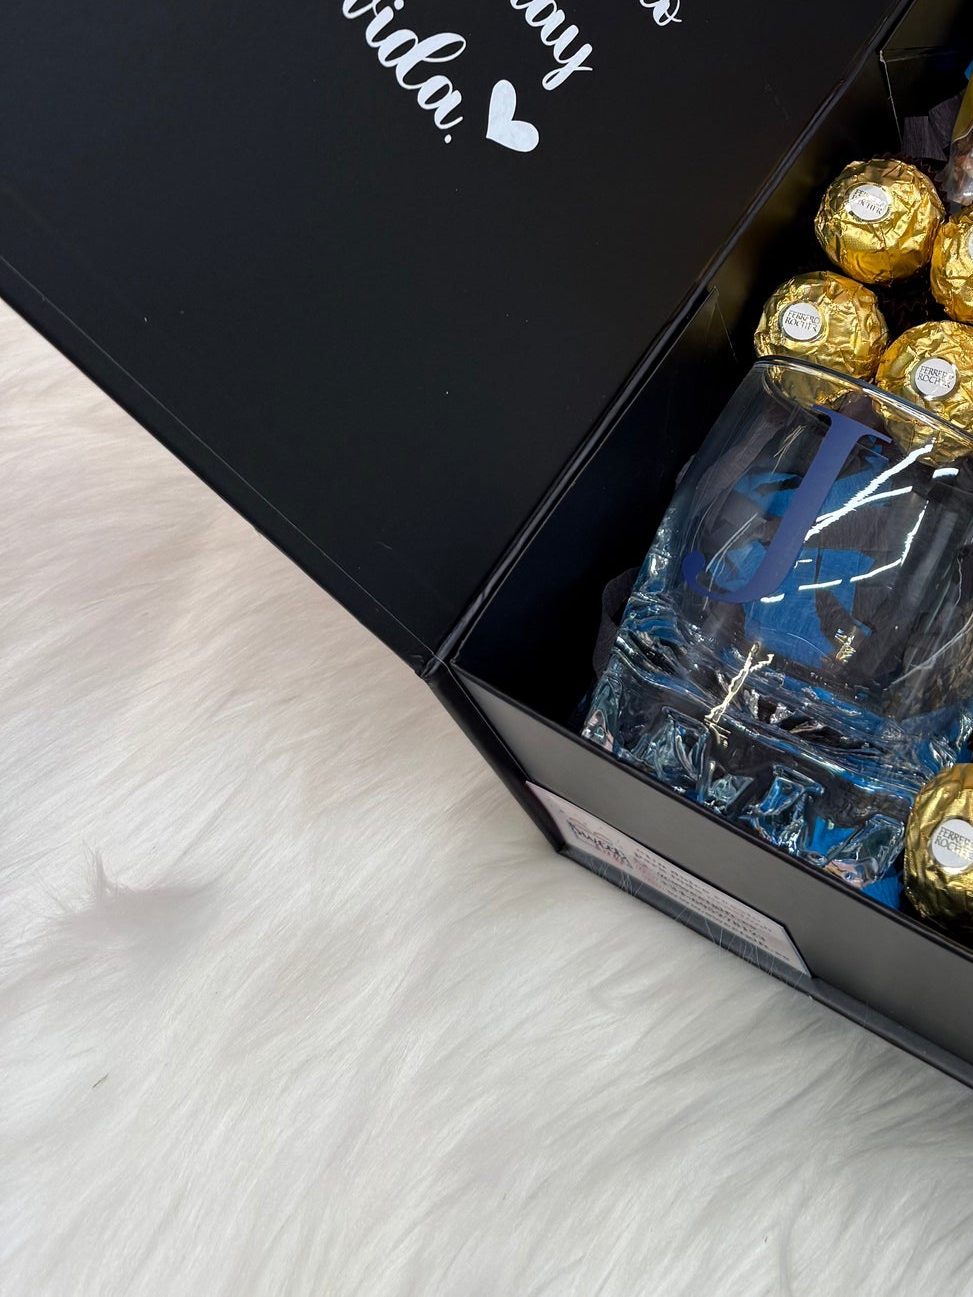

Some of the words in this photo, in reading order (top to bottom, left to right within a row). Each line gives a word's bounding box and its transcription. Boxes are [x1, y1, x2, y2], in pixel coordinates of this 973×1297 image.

[784, 317, 818, 333] ROCHER
[787, 311, 821, 325] FERRERO
[682, 404, 893, 603] J
